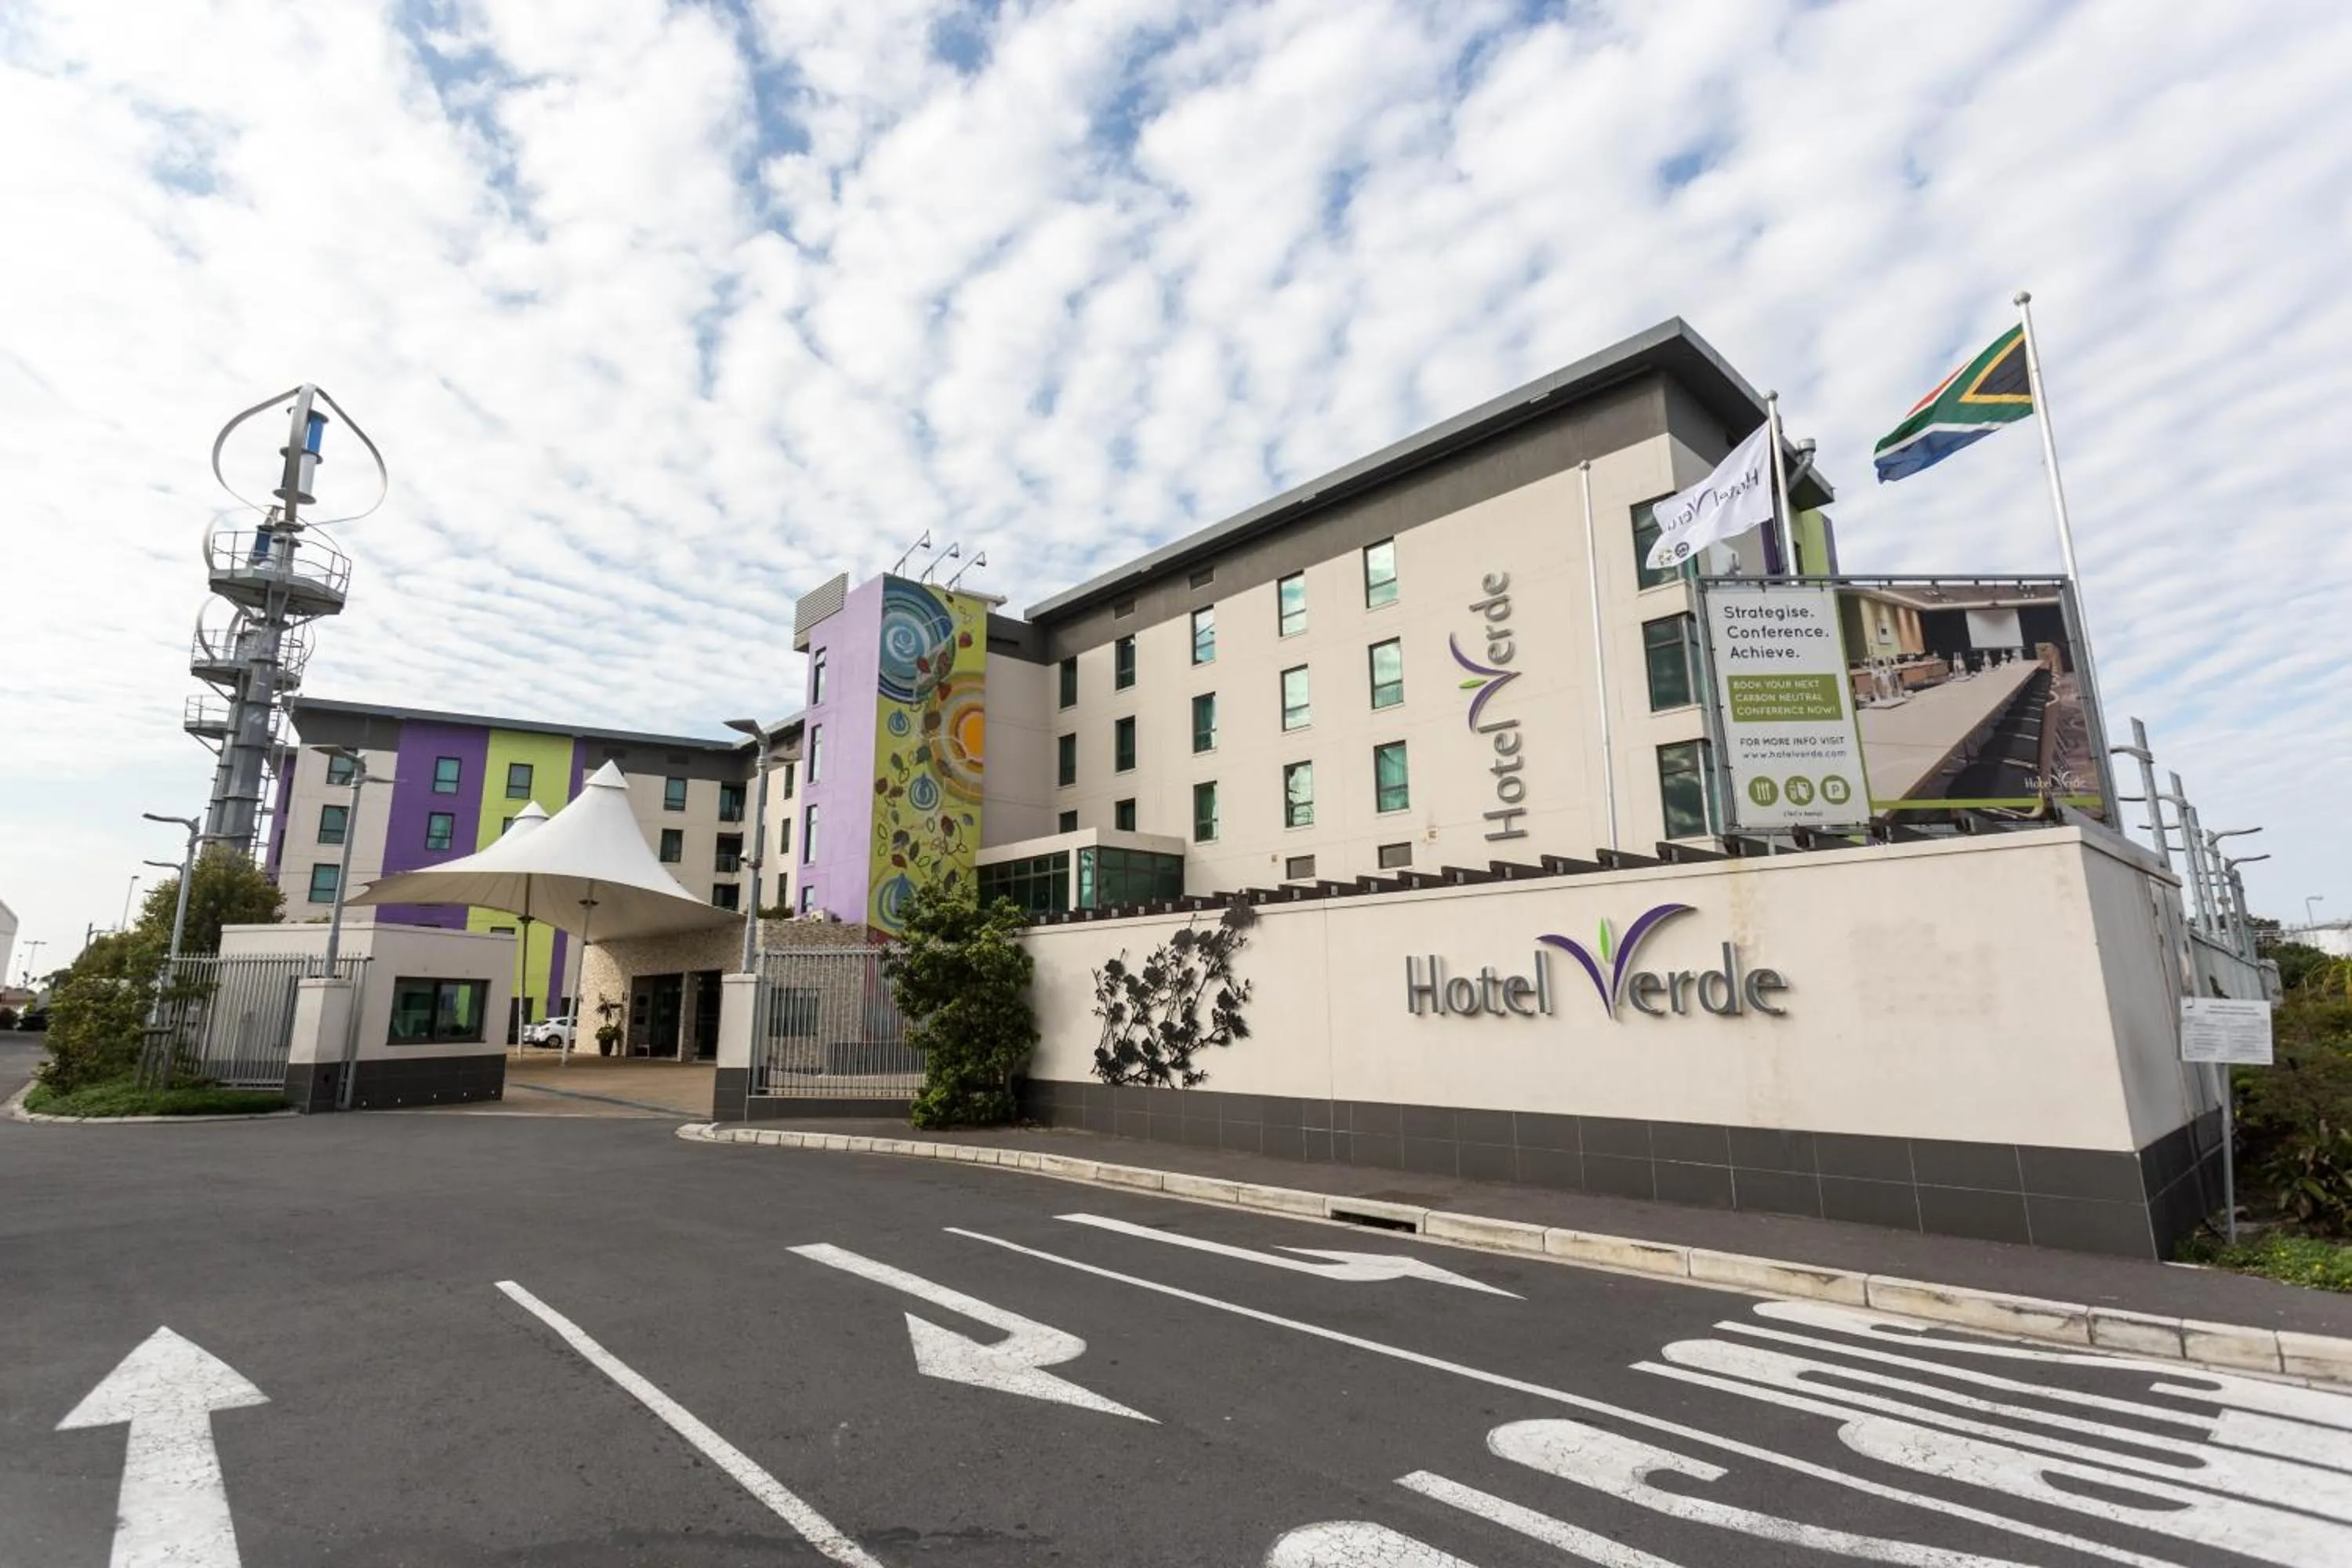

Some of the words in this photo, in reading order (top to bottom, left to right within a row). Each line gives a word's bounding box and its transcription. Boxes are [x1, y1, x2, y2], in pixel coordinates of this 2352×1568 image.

[1724, 605, 1815, 621] Strategise.
[1727, 625, 1829, 639] Conference.
[1449, 572, 1522, 734] Verde
[1730, 645, 1801, 659] Achieve.
[1733, 680, 1762, 689] BOOK
[1765, 680, 1792, 688] YOUR
[1794, 679, 1820, 688] NEXT
[1735, 693, 1777, 702] CARBON
[1779, 692, 1824, 702] NEUTRAL
[1737, 706, 1805, 716] CONFERENCE
[1807, 706, 1836, 714] NOW!
[1740, 737, 1760, 746] FOR
[1762, 737, 1791, 746] MORE
[1793, 736, 1817, 746] INFO
[1820, 736, 1845, 745] VISIT
[1477, 718, 1528, 841] Hotel
[1406, 950, 1553, 1017] Hotel
[1535, 902, 1791, 1021] Verde
